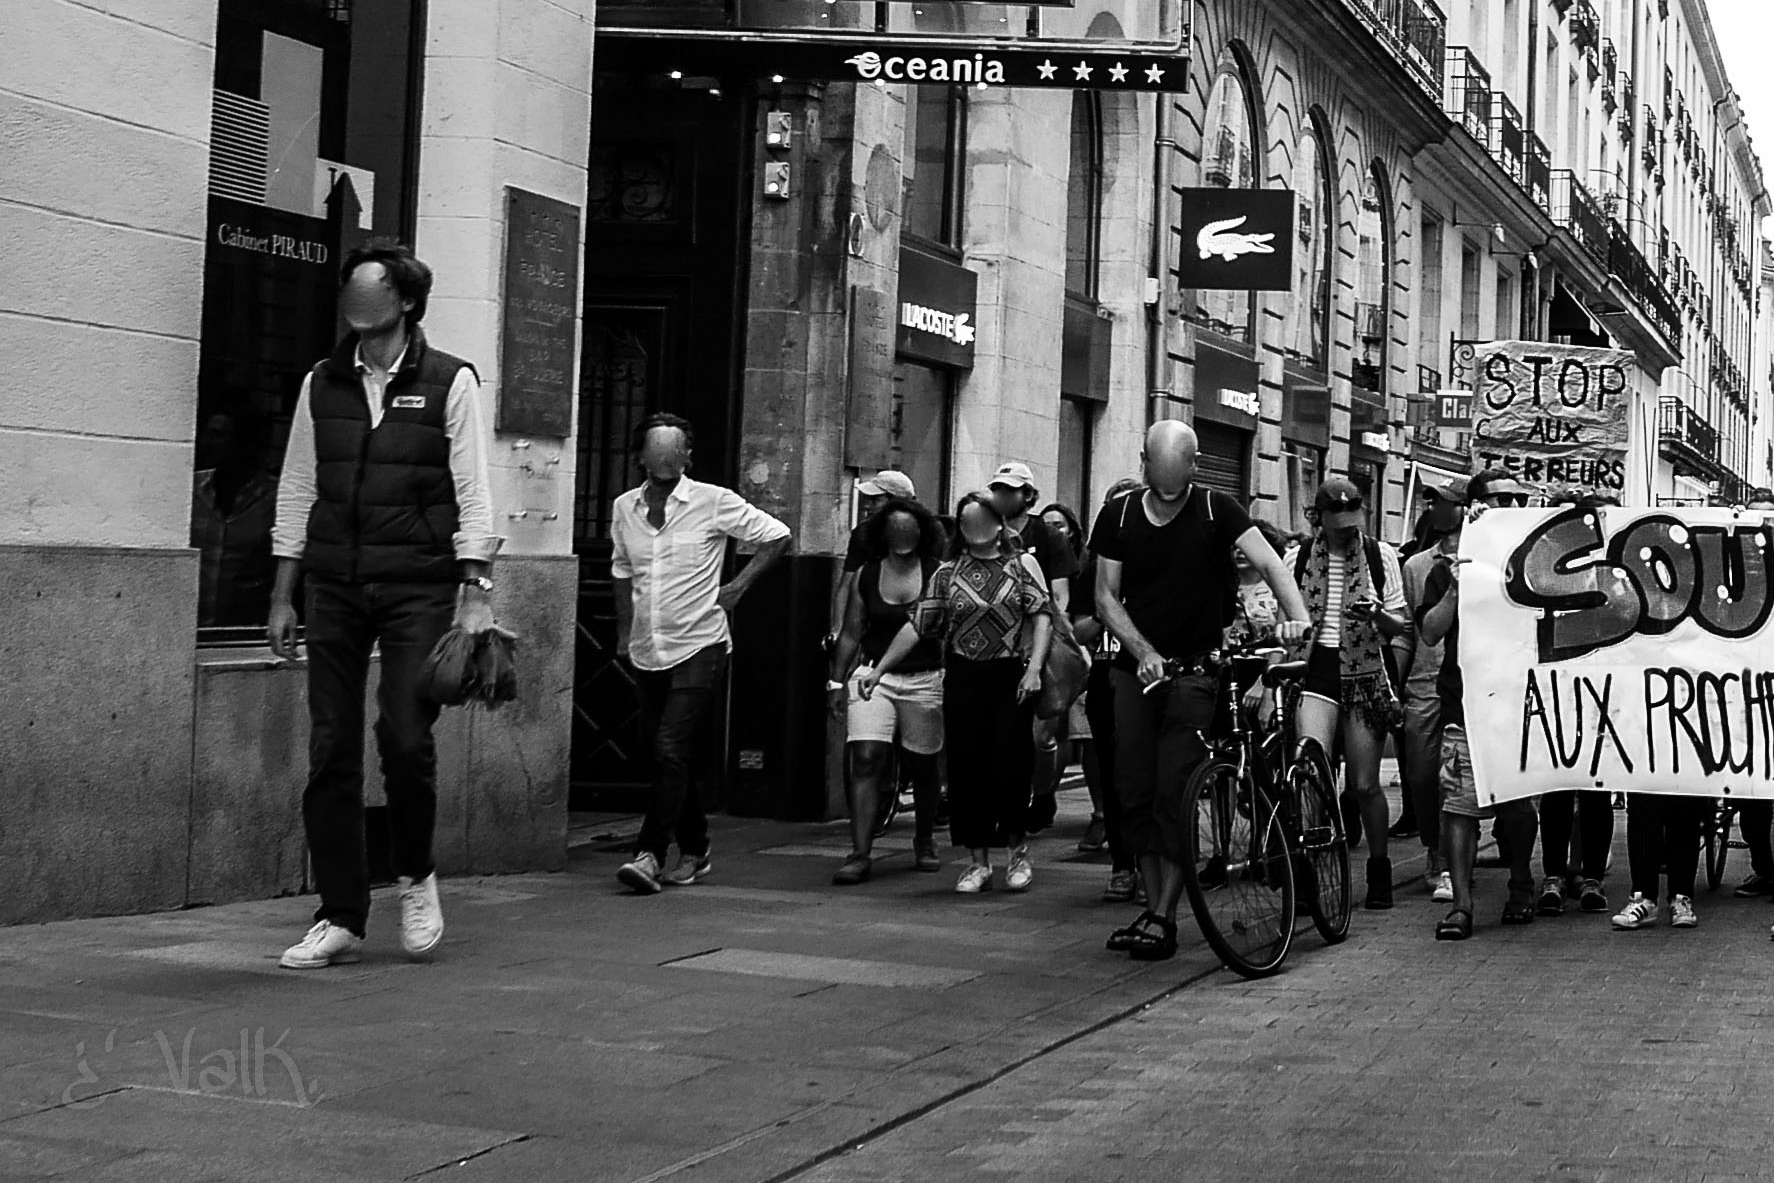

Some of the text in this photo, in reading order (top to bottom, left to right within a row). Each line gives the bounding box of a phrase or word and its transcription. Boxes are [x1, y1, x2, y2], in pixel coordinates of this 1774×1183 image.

[844, 50, 1005, 84] Oceania
[218, 222, 329, 264] Cabinet PIRAUD
[901, 302, 955, 338] LACOSTE
[1486, 352, 1626, 412] STOP
[1527, 415, 1583, 444] AUX
[1519, 668, 1633, 777] AUX
